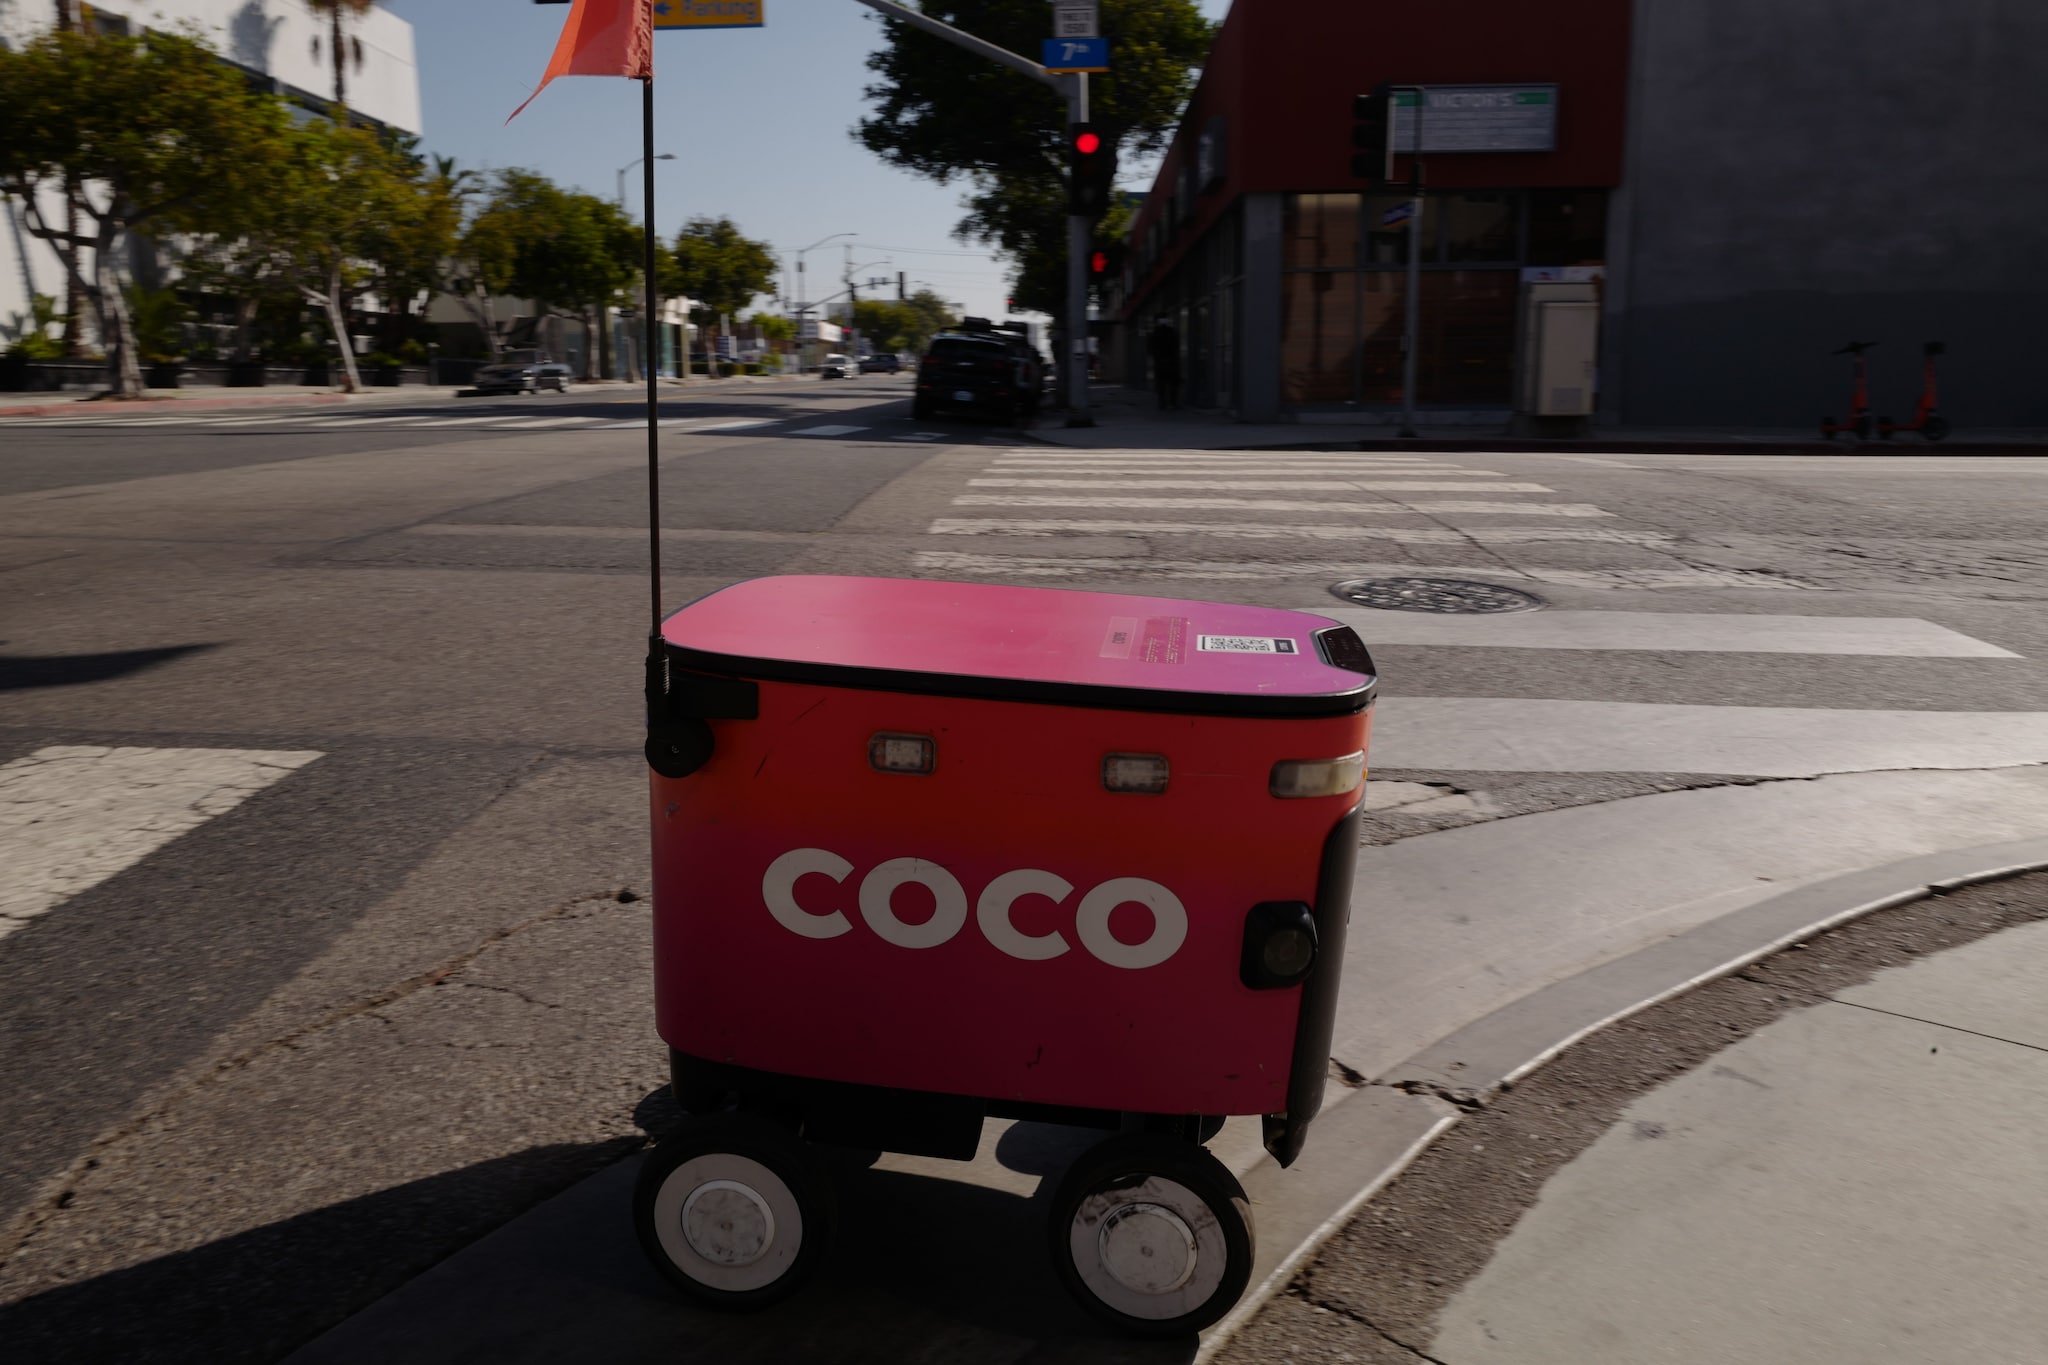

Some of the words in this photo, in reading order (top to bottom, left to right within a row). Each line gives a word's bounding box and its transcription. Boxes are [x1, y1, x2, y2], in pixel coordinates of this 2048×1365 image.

[683, 0, 757, 20] Parking
[1060, 42, 1090, 61] 7th
[762, 847, 1188, 969] COCO
